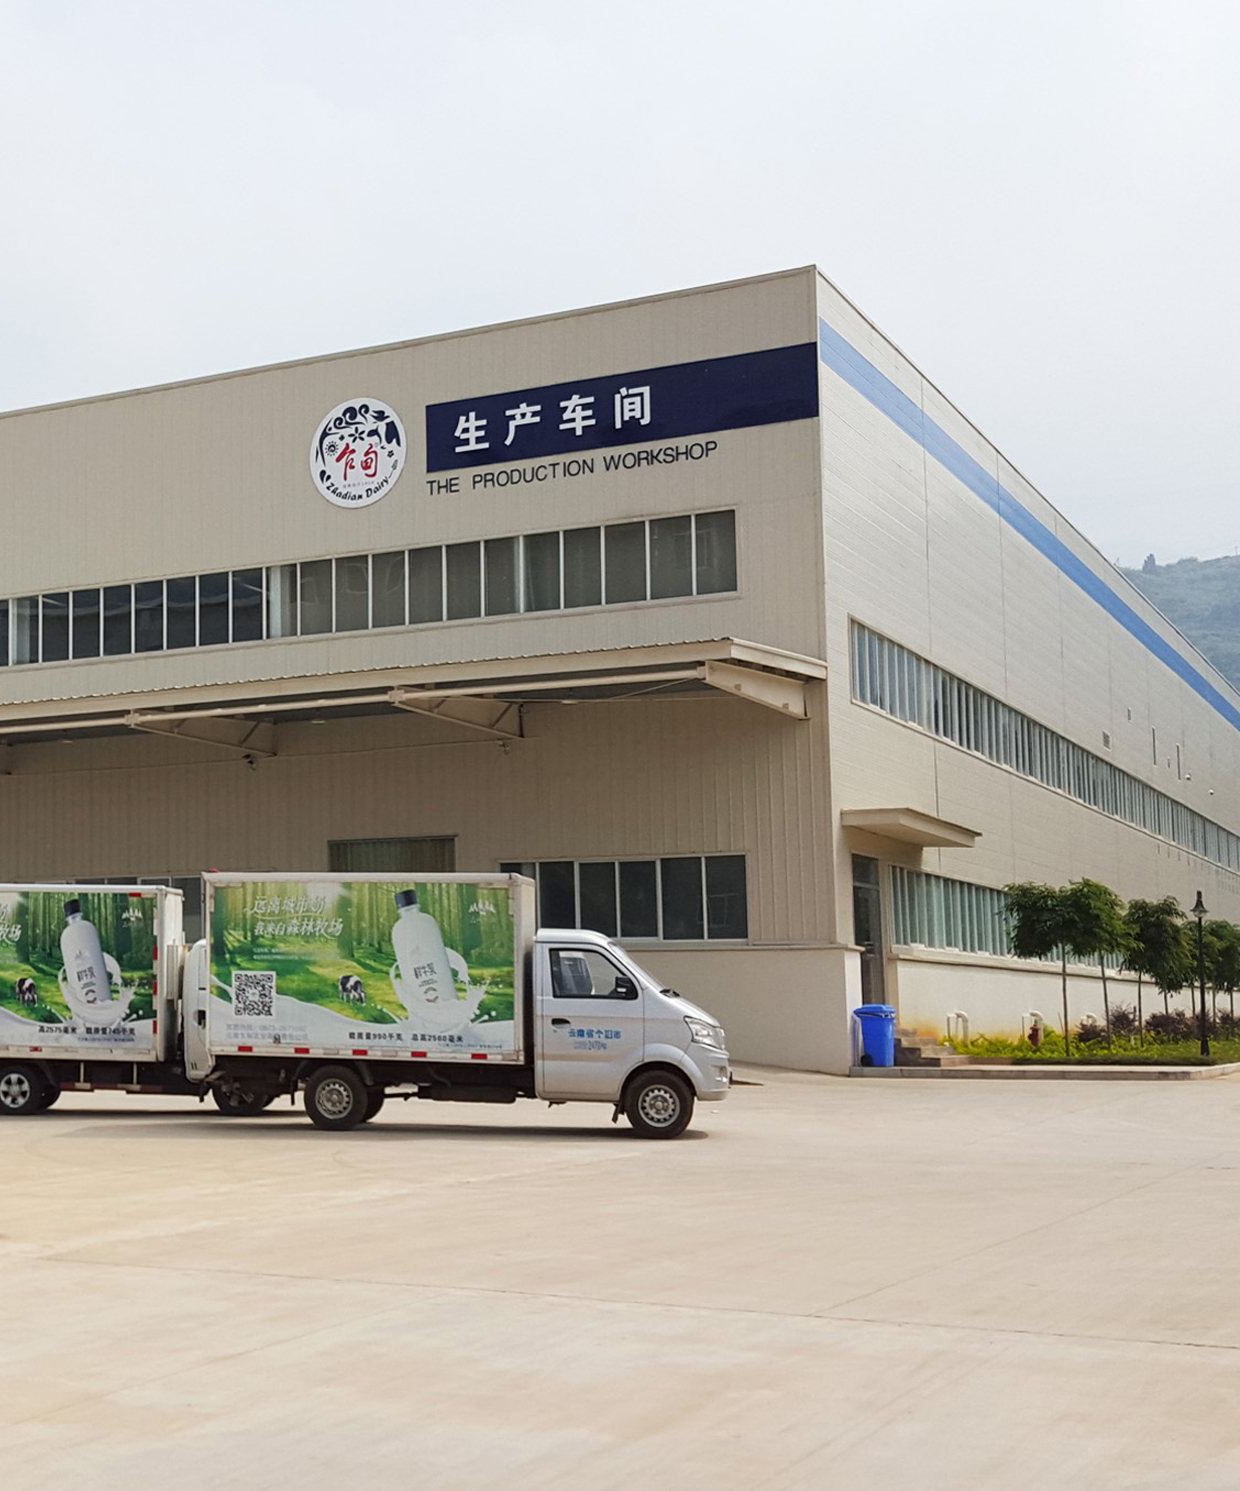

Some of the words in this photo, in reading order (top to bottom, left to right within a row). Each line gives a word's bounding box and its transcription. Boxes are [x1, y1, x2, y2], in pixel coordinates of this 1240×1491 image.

[454, 385, 652, 453] 生产车间
[326, 482, 364, 501] Zhadian
[365, 475, 390, 499] Dairy
[426, 477, 460, 496] THE
[472, 458, 595, 490] PRODUCTION
[603, 440, 718, 472] WORKSHOP
[254, 918, 343, 940] 我来自森林牧场
